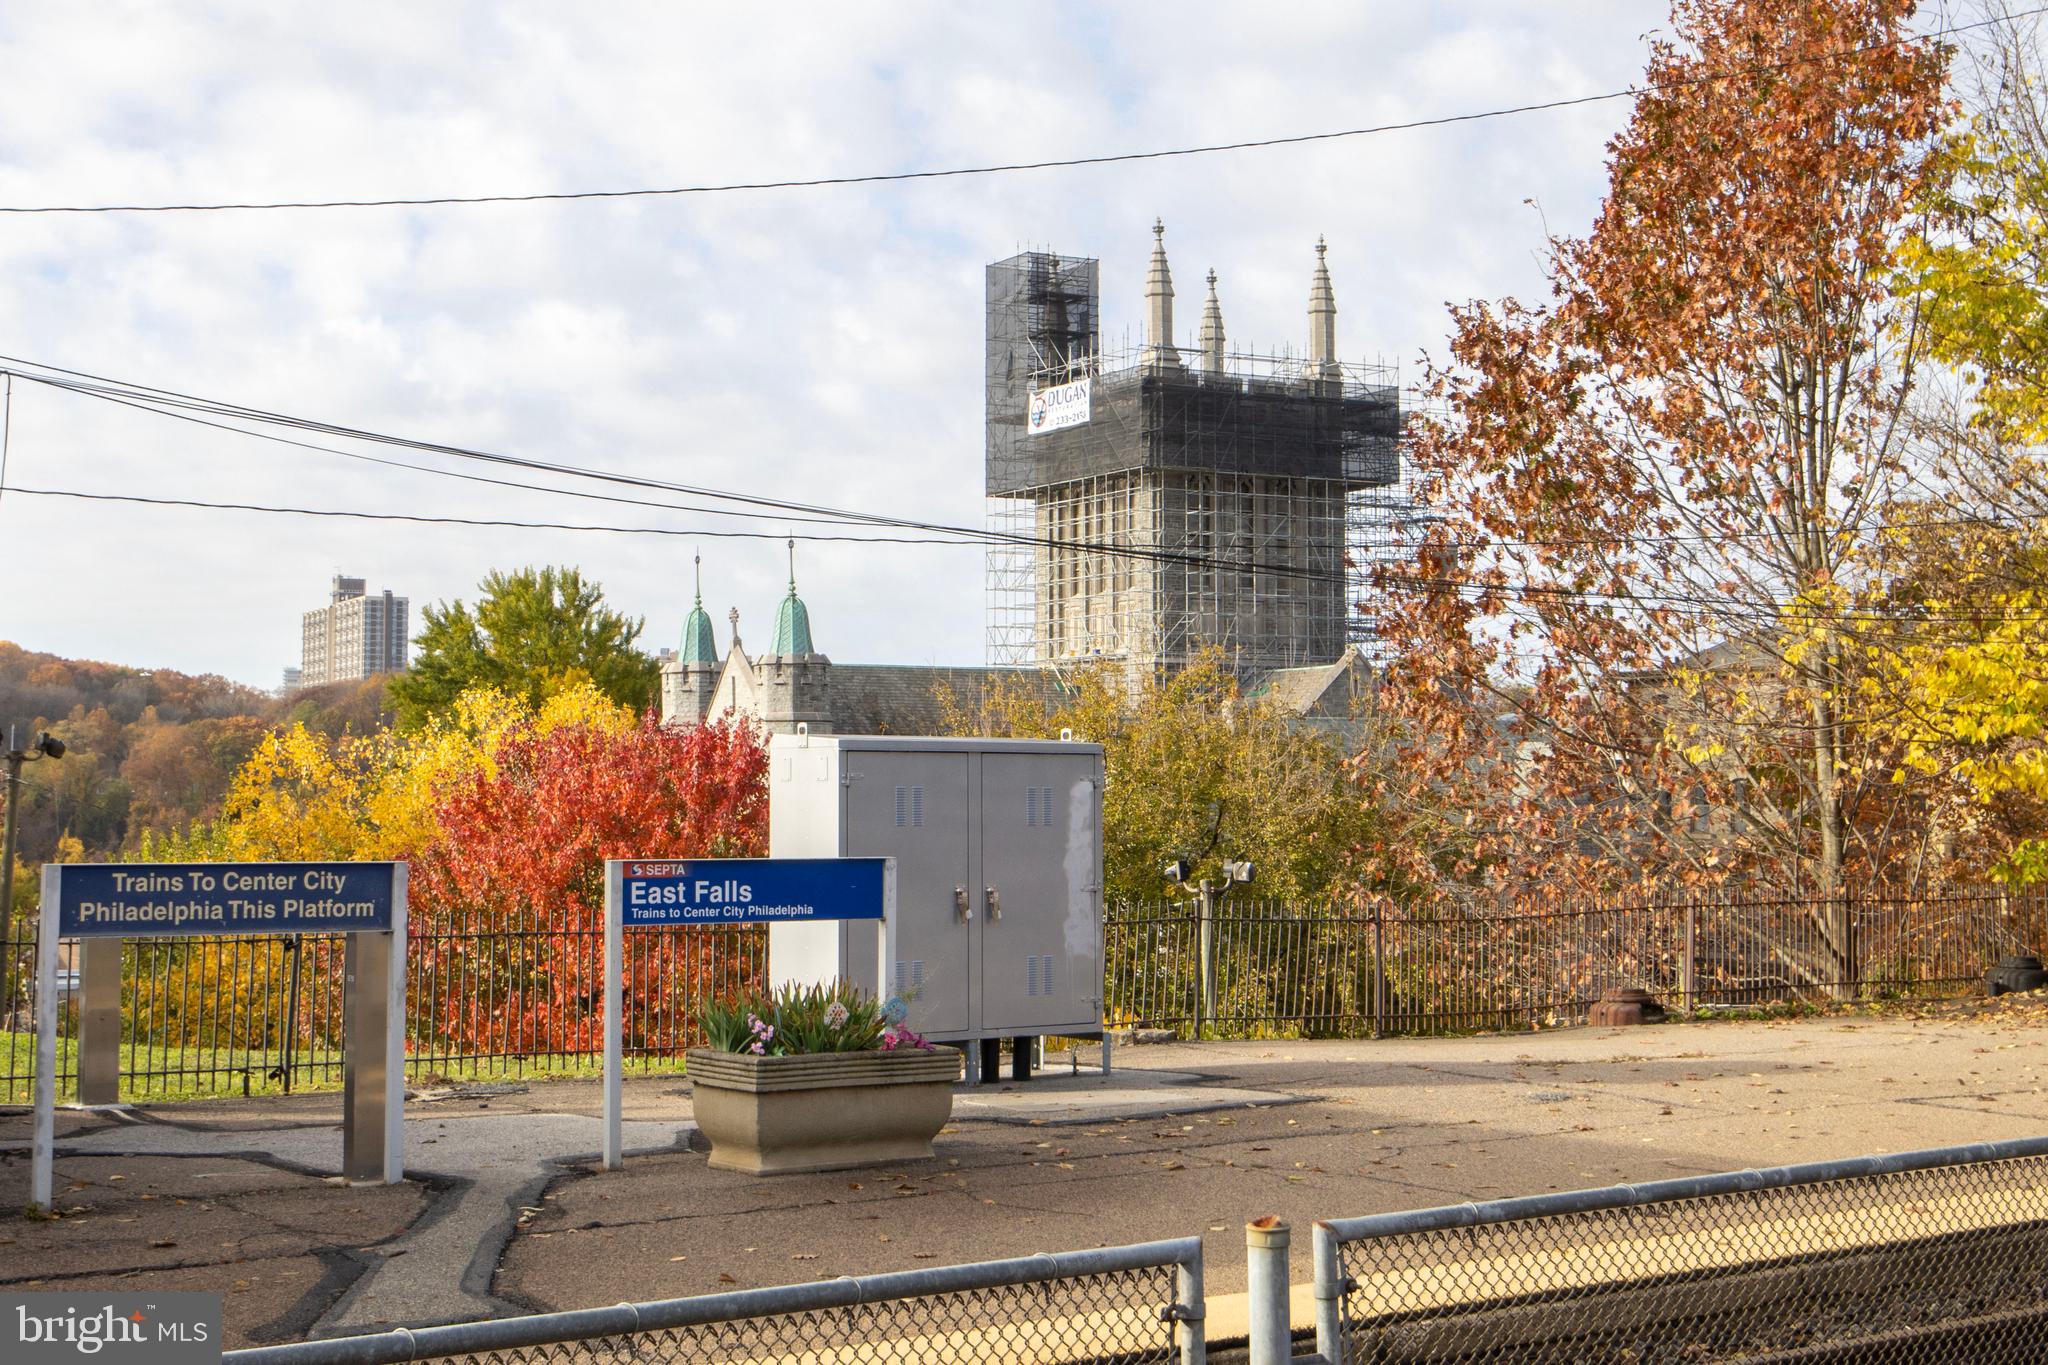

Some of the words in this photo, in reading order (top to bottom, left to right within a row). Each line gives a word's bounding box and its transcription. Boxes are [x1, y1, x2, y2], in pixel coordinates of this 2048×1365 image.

[1048, 382, 1087, 407] DUGAN
[646, 863, 685, 875] SEPTA
[112, 872, 184, 892] Trains
[188, 872, 216, 891] To
[223, 871, 297, 891] Center
[303, 871, 346, 894] City
[631, 881, 686, 904] East
[695, 880, 752, 903] Falls
[79, 901, 223, 925] Philadelphia
[228, 900, 276, 919] This
[284, 899, 375, 918] Platform
[632, 908, 666, 919] Trains
[669, 908, 680, 918] to
[684, 907, 721, 918] Center
[723, 906, 745, 919] City
[748, 904, 813, 916] Philadelphia
